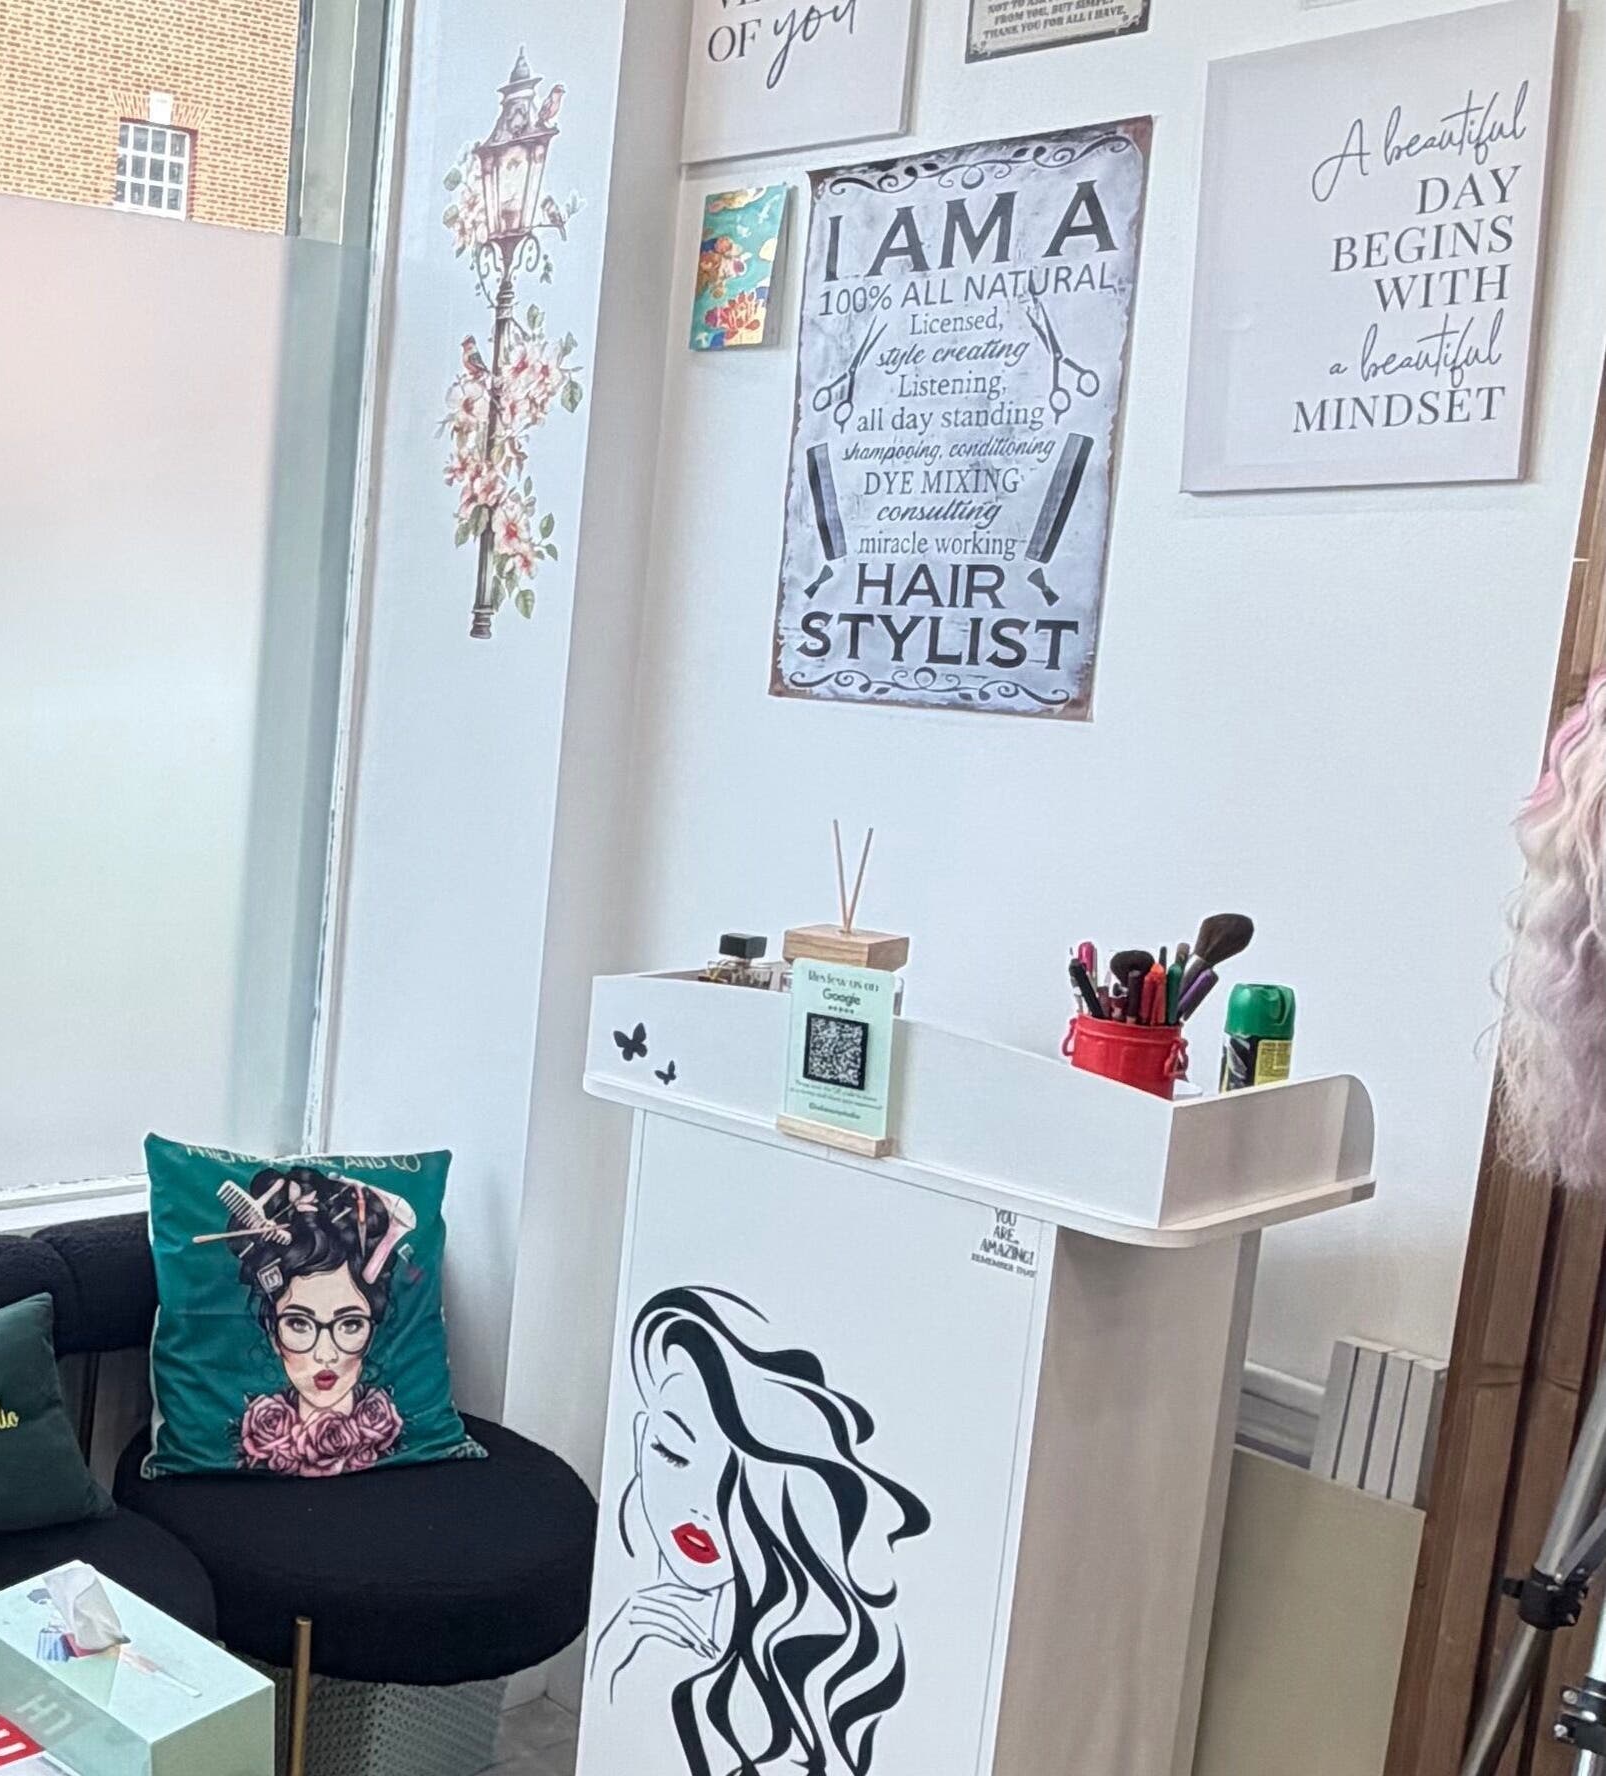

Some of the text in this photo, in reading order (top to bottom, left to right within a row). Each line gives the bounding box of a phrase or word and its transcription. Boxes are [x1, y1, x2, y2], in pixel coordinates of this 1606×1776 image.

[983, 25, 1018, 39] THANK
[1021, 19, 1041, 32] YOU
[1043, 16, 1064, 29] FOR
[1066, 12, 1085, 24] ALL
[1094, 5, 1127, 19] HAVE.
[994, 11, 1025, 25] FROM
[1052, 2, 1074, 14] BUT
[708, 0, 857, 89] OF you
[1312, 80, 1529, 202] A beautiful
[1415, 165, 1522, 215] DAY
[824, 180, 1119, 282] I AM A
[1331, 214, 1514, 272] BEGINS
[818, 262, 1116, 316] 100% ALL NATURAL
[1374, 264, 1512, 312] WITH
[910, 306, 1004, 336] Licensed,
[876, 339, 1031, 375] style creating
[1329, 307, 1503, 388] a beautiful
[898, 370, 1007, 400] Listening,
[856, 401, 1045, 436] all day standing
[1293, 386, 1506, 433] MINDSET
[842, 436, 1056, 467] shampooing, conditioning
[864, 467, 1019, 496] DYE MIXING
[876, 498, 1003, 530] consulting
[858, 529, 1018, 561] miracle working
[855, 562, 1006, 609] HAIR
[796, 611, 1079, 671] STYLIST
[822, 988, 861, 1007] Google
[995, 1207, 1017, 1227] YOU
[980, 1238, 1034, 1266] AMAZING!
